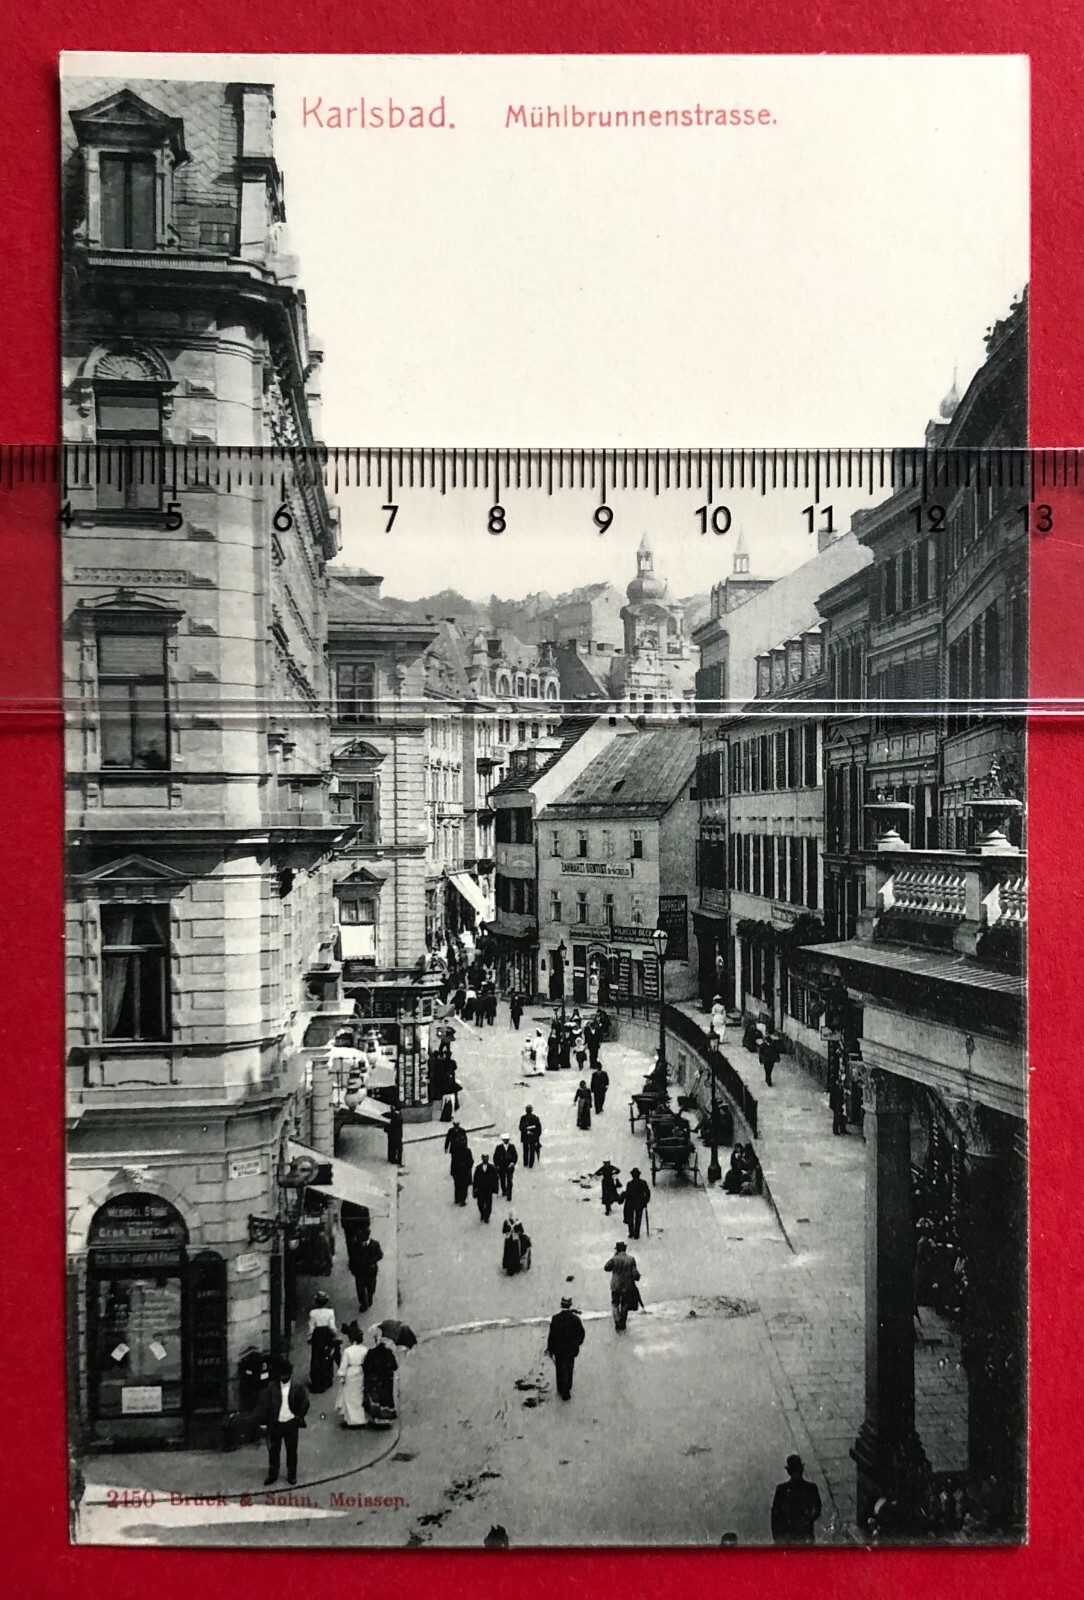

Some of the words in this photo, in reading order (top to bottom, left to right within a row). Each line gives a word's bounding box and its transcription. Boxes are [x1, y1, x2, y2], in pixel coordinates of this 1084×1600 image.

[56, 508, 75, 529] 4
[163, 502, 184, 532] 5
[273, 503, 293, 533] 6
[381, 505, 399, 534] 7
[487, 505, 507, 535] 8
[594, 505, 614, 535] 9
[694, 505, 732, 535] 10
[801, 505, 836, 534] 11
[908, 505, 947, 534] 12
[1020, 504, 1053, 533] 13
